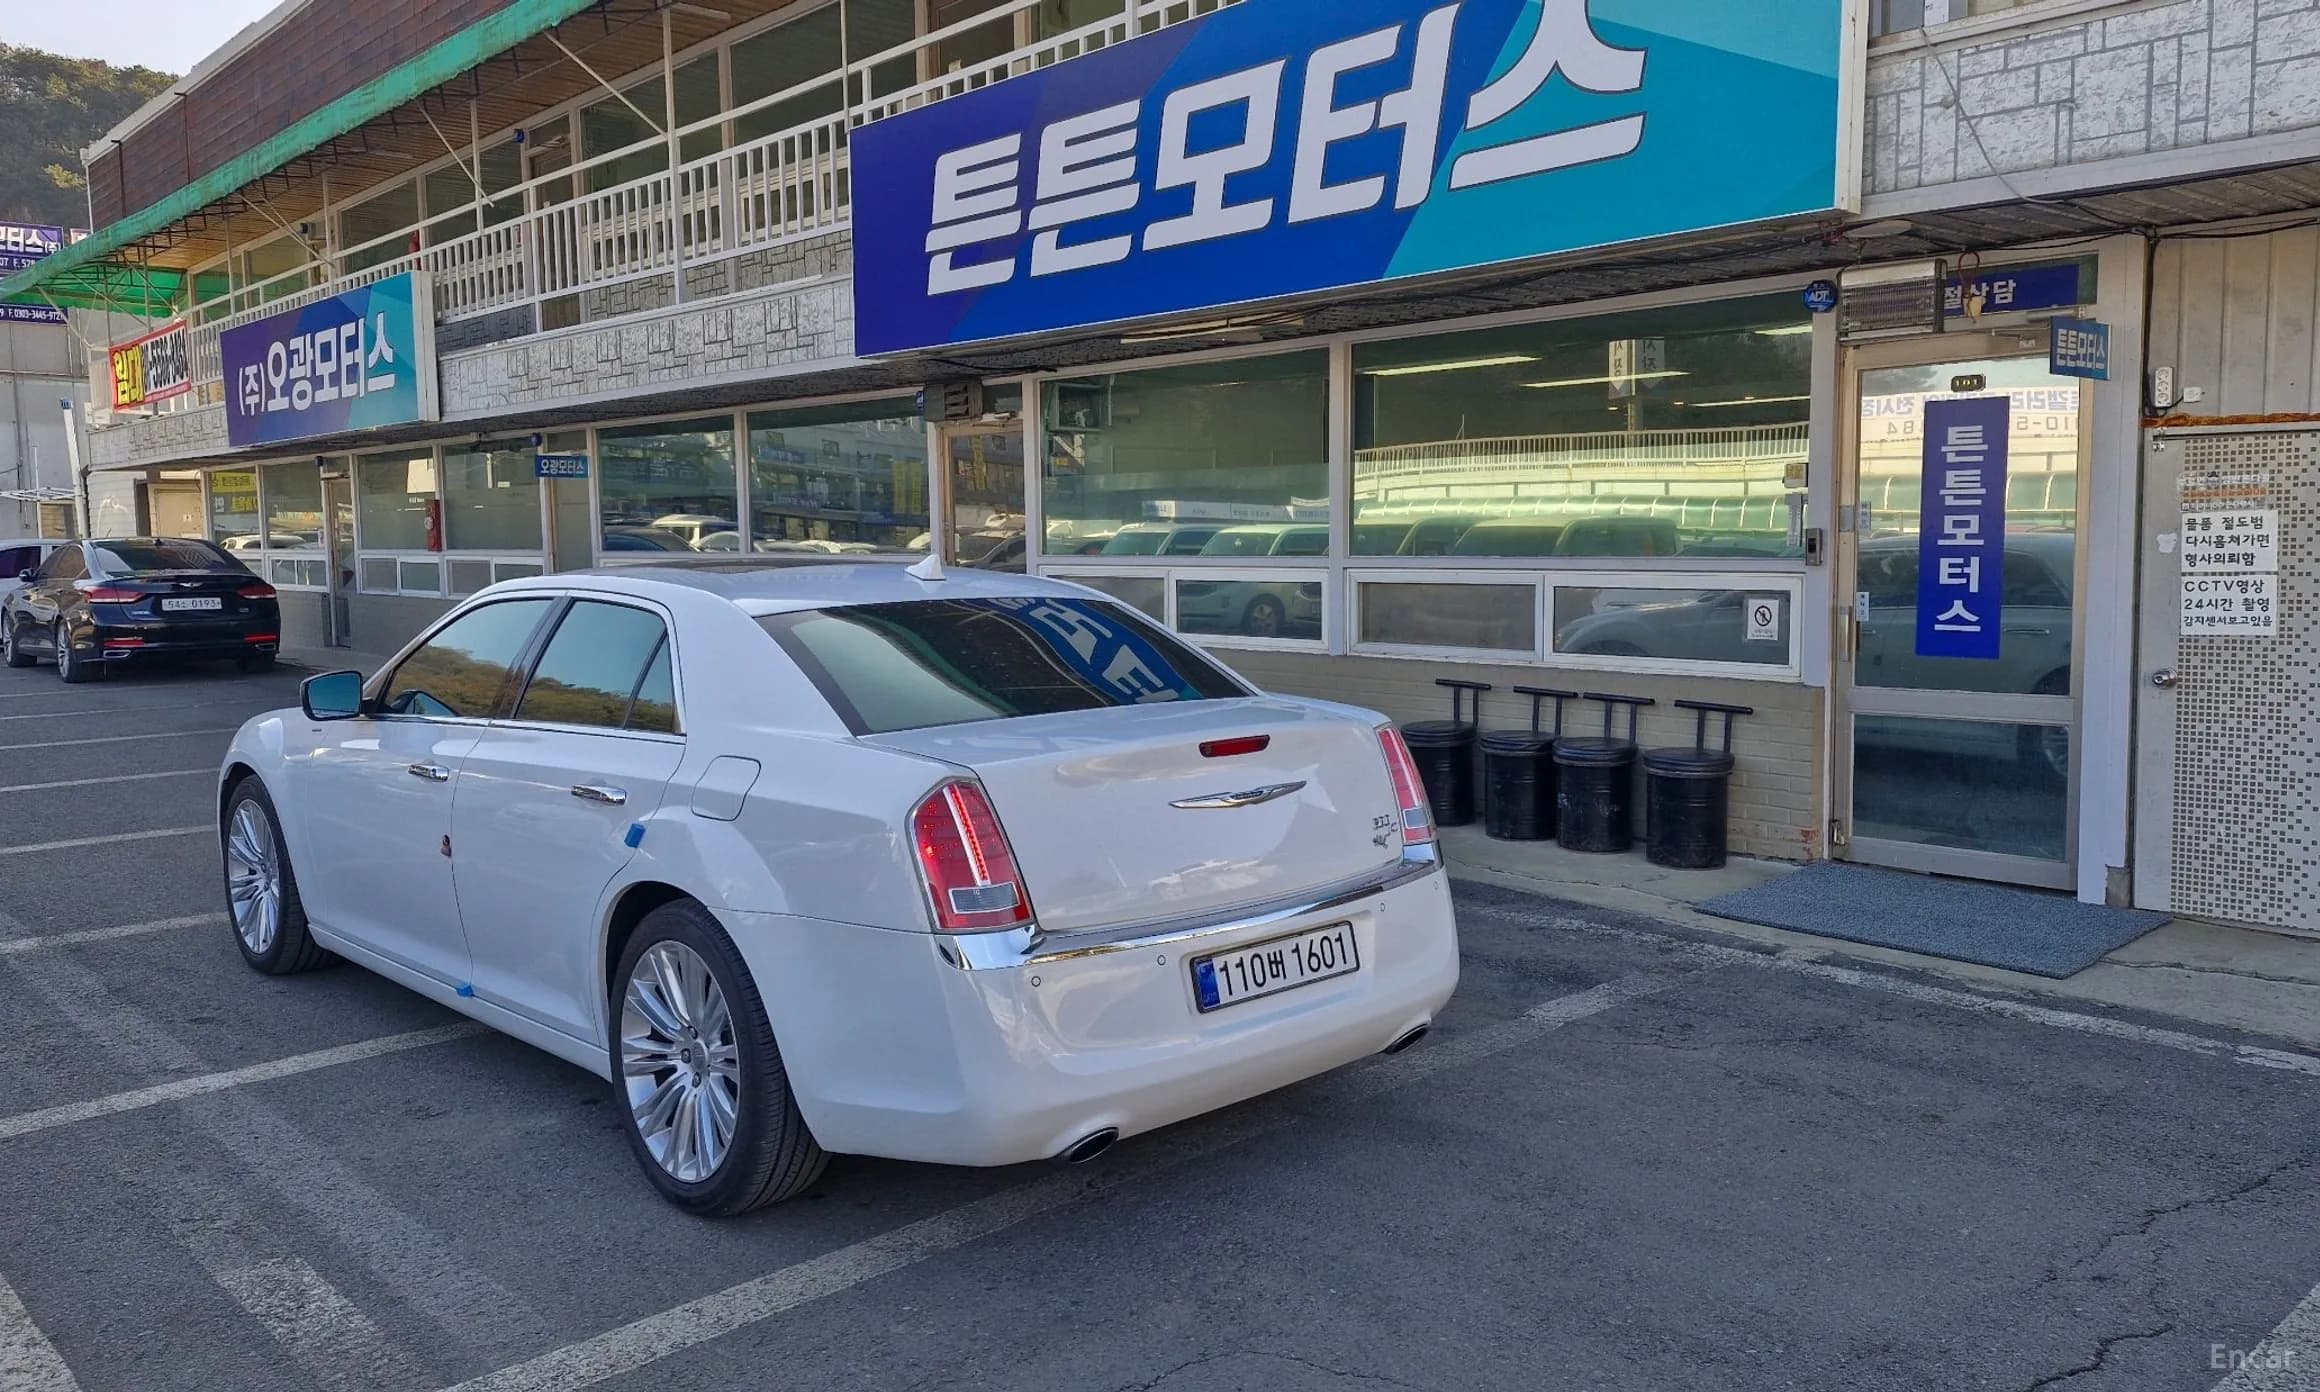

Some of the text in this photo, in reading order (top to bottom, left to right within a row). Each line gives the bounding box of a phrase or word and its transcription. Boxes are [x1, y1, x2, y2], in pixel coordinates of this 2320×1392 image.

[924, 0, 1648, 297] 튼튼모터스
[239, 311, 395, 417] (주)오광모터스
[2056, 328, 2106, 370] 튼튼모터스
[540, 459, 585, 477] 오광모터스
[1934, 425, 1989, 632] 튼튼모터스
[2185, 515, 2263, 532] 물품 절도범
[2184, 552, 2256, 567] 형사의뢰함
[2184, 579, 2265, 594] CCTV영상
[2184, 597, 2270, 613] 24시간 촬영
[1218, 931, 1348, 997] 110버 1601
